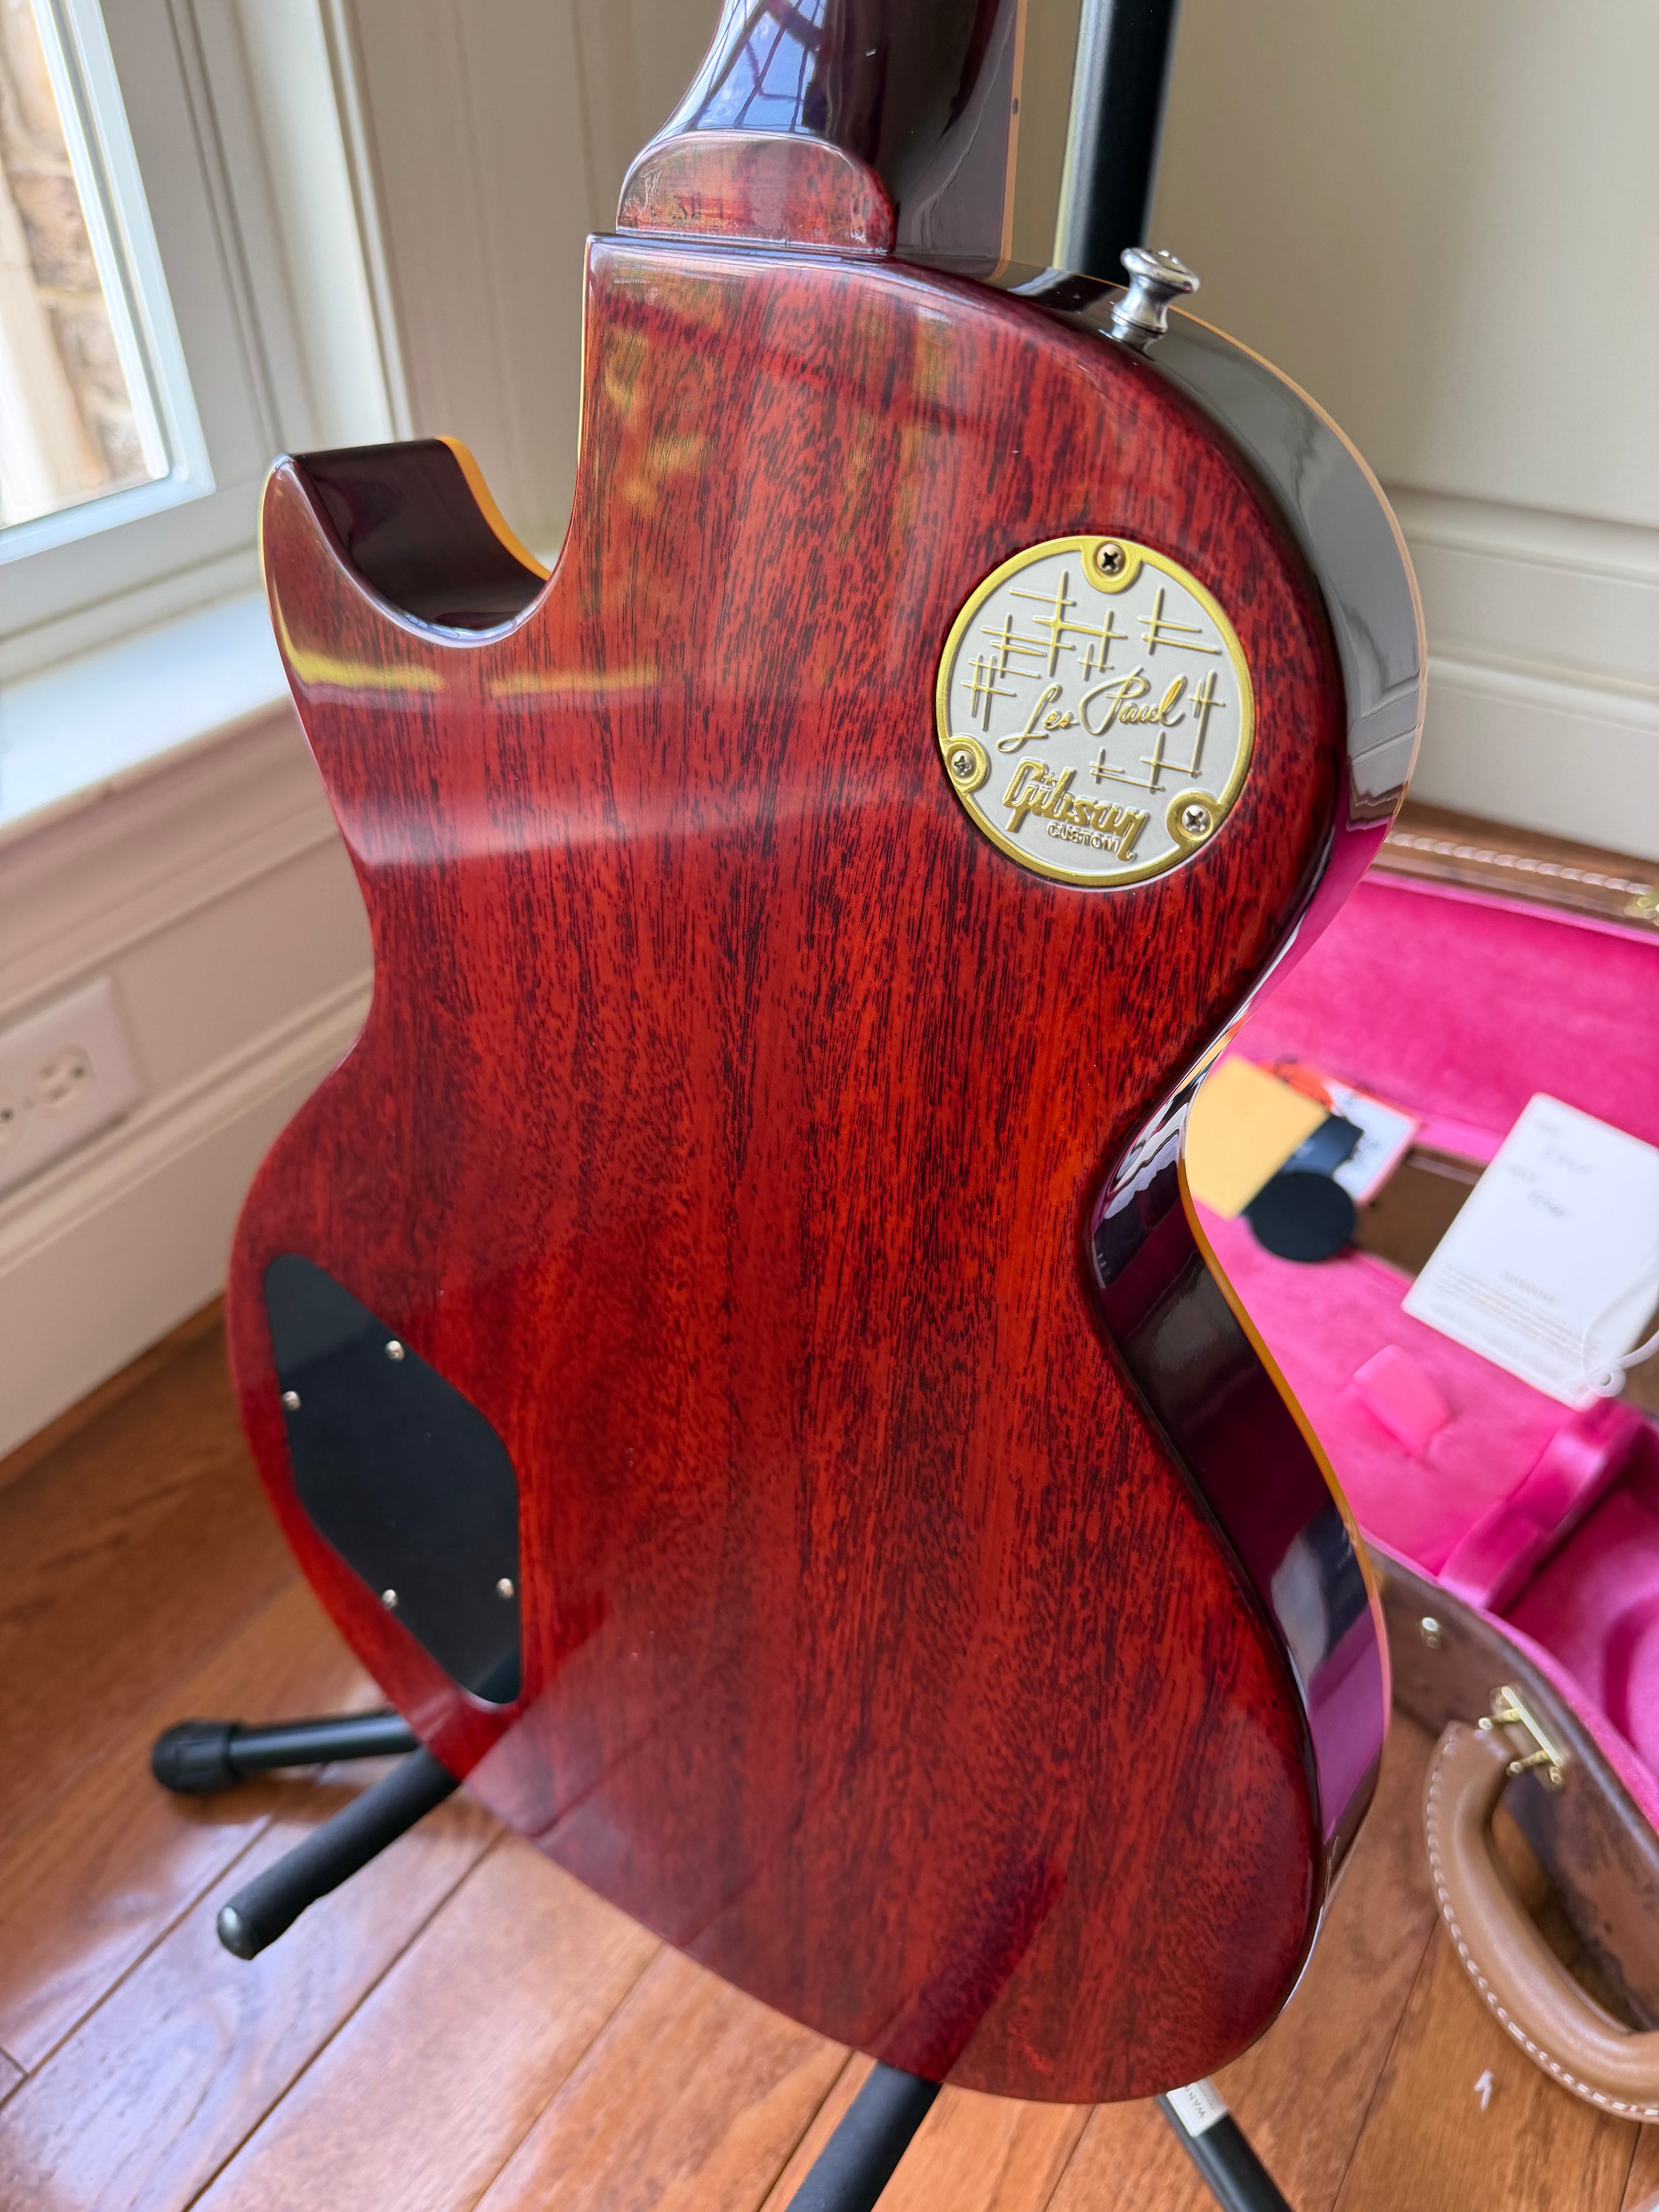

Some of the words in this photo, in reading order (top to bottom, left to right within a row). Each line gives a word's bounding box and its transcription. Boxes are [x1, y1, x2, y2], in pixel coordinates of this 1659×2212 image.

[996, 682, 1078, 754] Les
[1078, 665, 1187, 736] Paul
[1002, 756, 1150, 862] Gibson
[1046, 821, 1122, 854] CUSTOM
